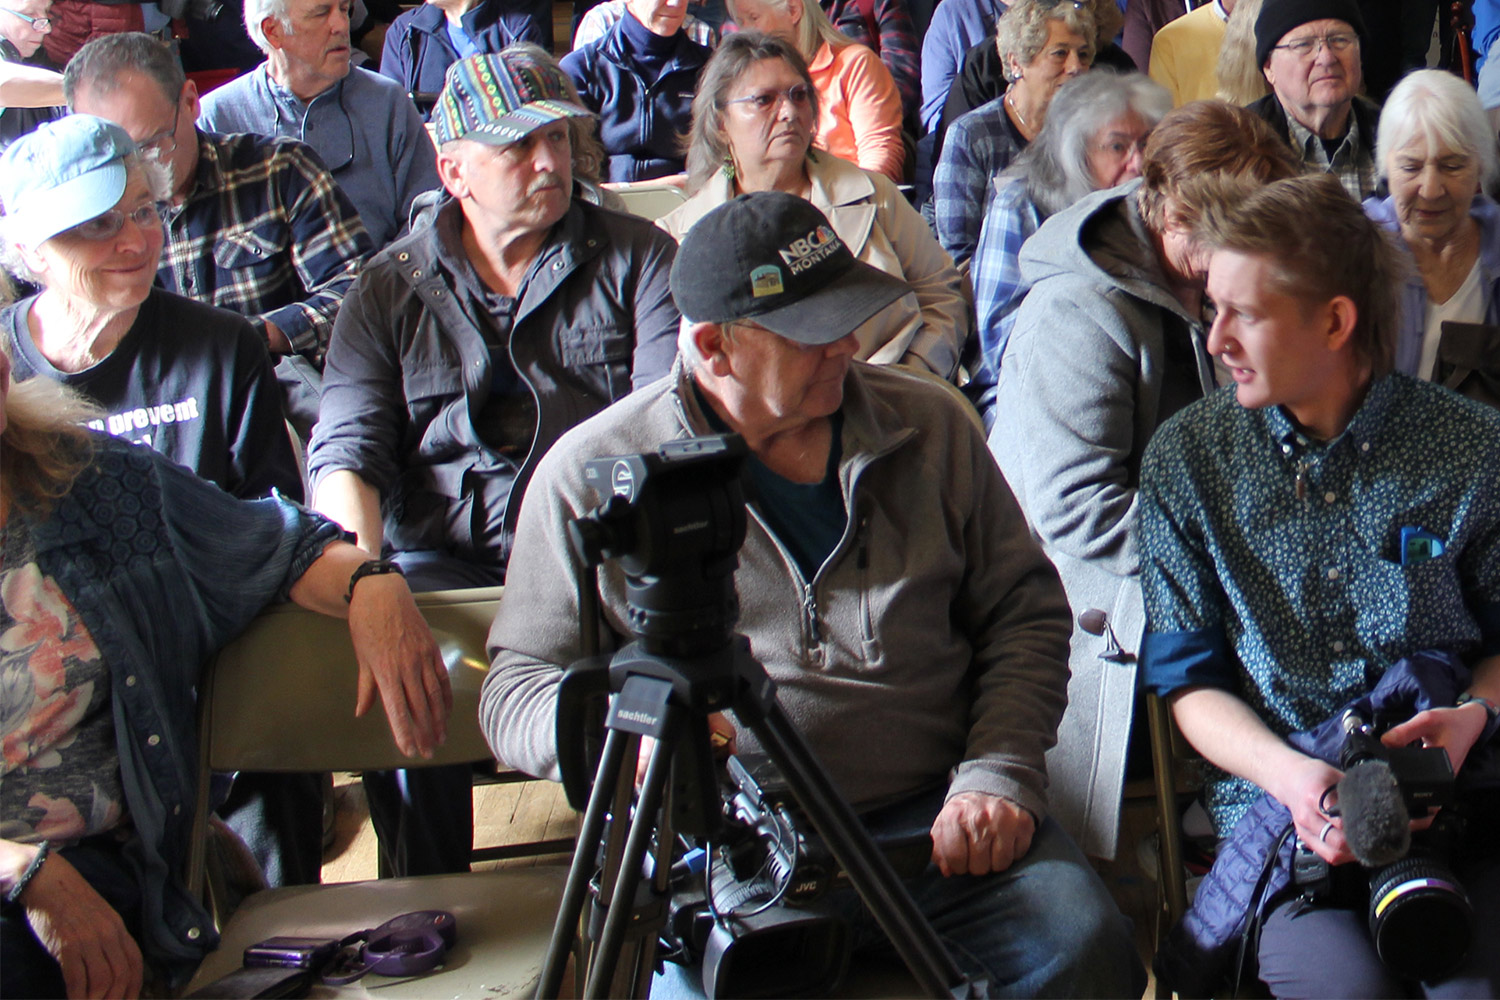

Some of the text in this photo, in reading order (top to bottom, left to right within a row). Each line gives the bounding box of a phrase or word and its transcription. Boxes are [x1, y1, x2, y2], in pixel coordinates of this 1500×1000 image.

[778, 230, 821, 265] NBC
[789, 239, 842, 276] MONTANA
[107, 397, 199, 436] prevent
[617, 709, 658, 726] sachtler
[795, 880, 817, 893] JVC
